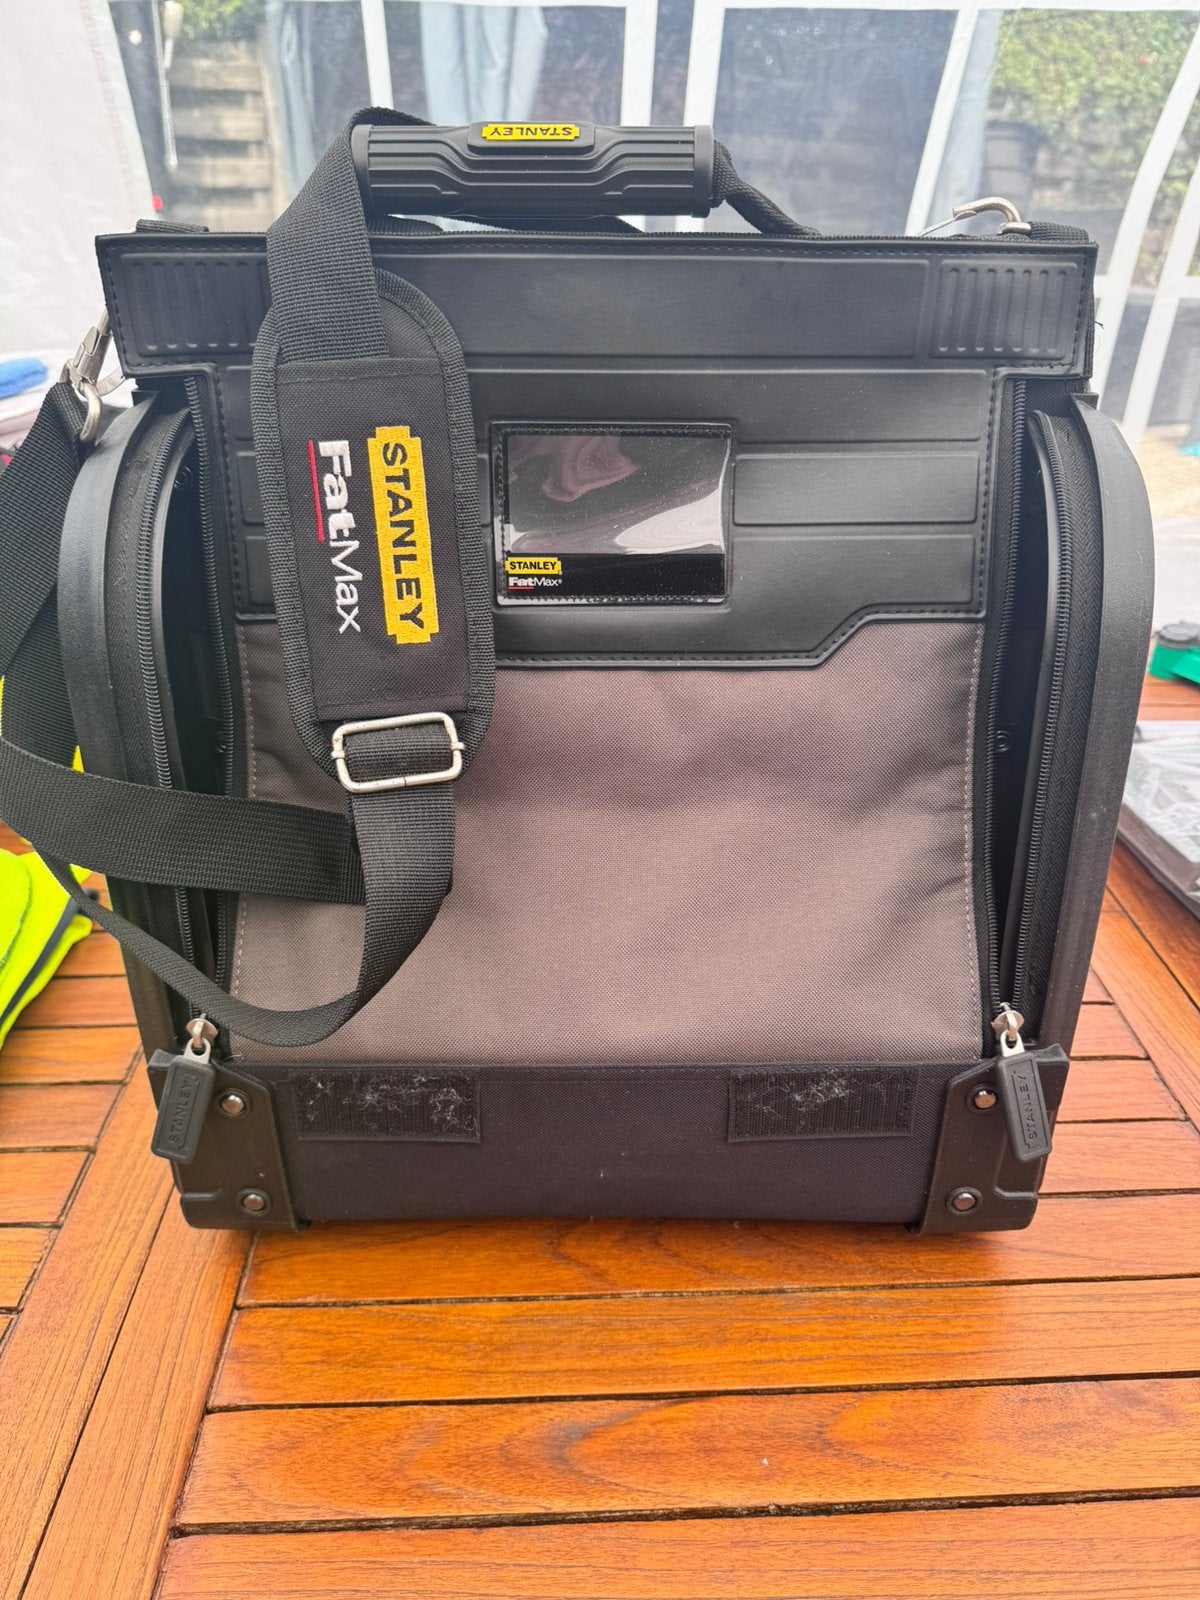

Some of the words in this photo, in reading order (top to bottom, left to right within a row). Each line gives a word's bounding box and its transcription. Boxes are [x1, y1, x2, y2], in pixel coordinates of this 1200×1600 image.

[490, 127, 573, 136] STANLEY
[318, 440, 363, 634] FatMax
[381, 442, 425, 630] STANLEY
[509, 561, 557, 571] STANLEY
[168, 1079, 194, 1143] STANLEY
[1018, 1073, 1038, 1141] STANLEY
